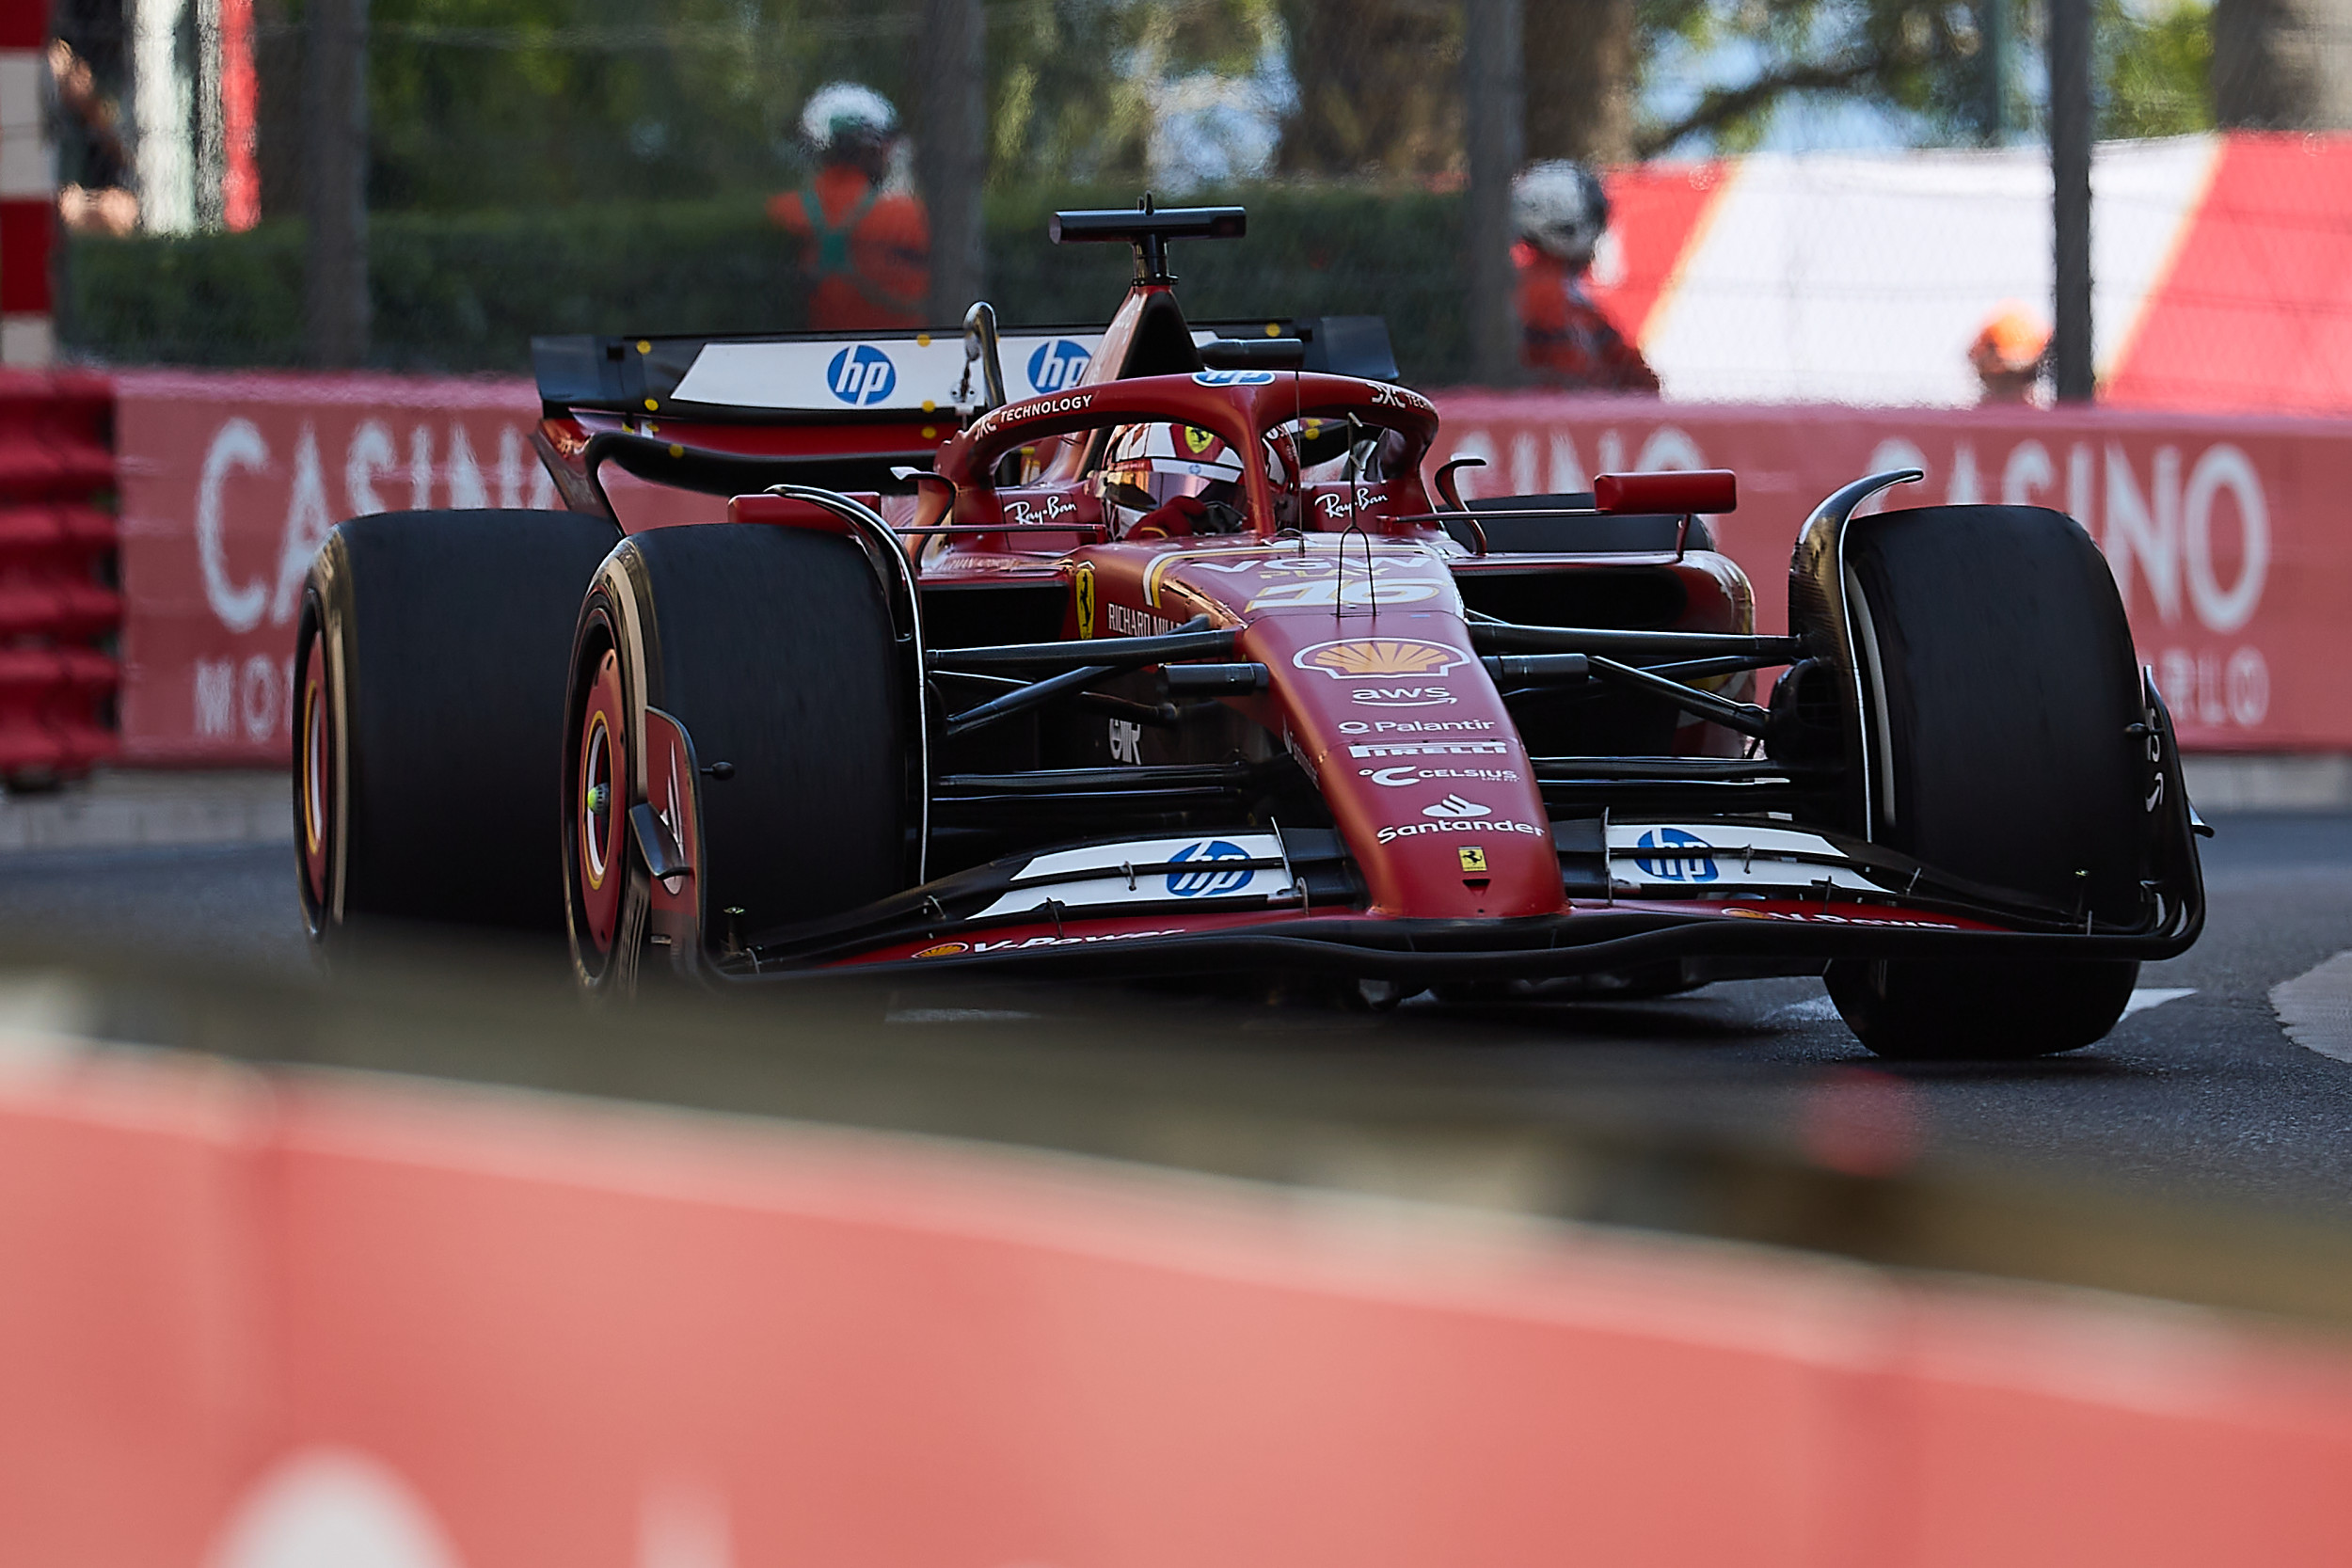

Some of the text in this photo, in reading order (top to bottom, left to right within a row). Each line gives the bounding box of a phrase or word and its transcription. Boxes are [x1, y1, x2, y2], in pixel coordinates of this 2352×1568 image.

[830, 343, 894, 405] hp
[1000, 394, 1092, 423] TECHNOLOGY
[1190, 557, 1432, 573] VGW
[1245, 578, 1449, 613] 16
[1107, 603, 1151, 638] RICHARD
[1351, 687, 1452, 701] aws
[1375, 720, 1496, 734] Palantir
[1348, 741, 1507, 758] PIRELLI
[1419, 768, 1518, 779] CELSIUS
[1376, 819, 1544, 845] Santander
[1168, 841, 1253, 896] hp
[975, 928, 1185, 952] V-Power
